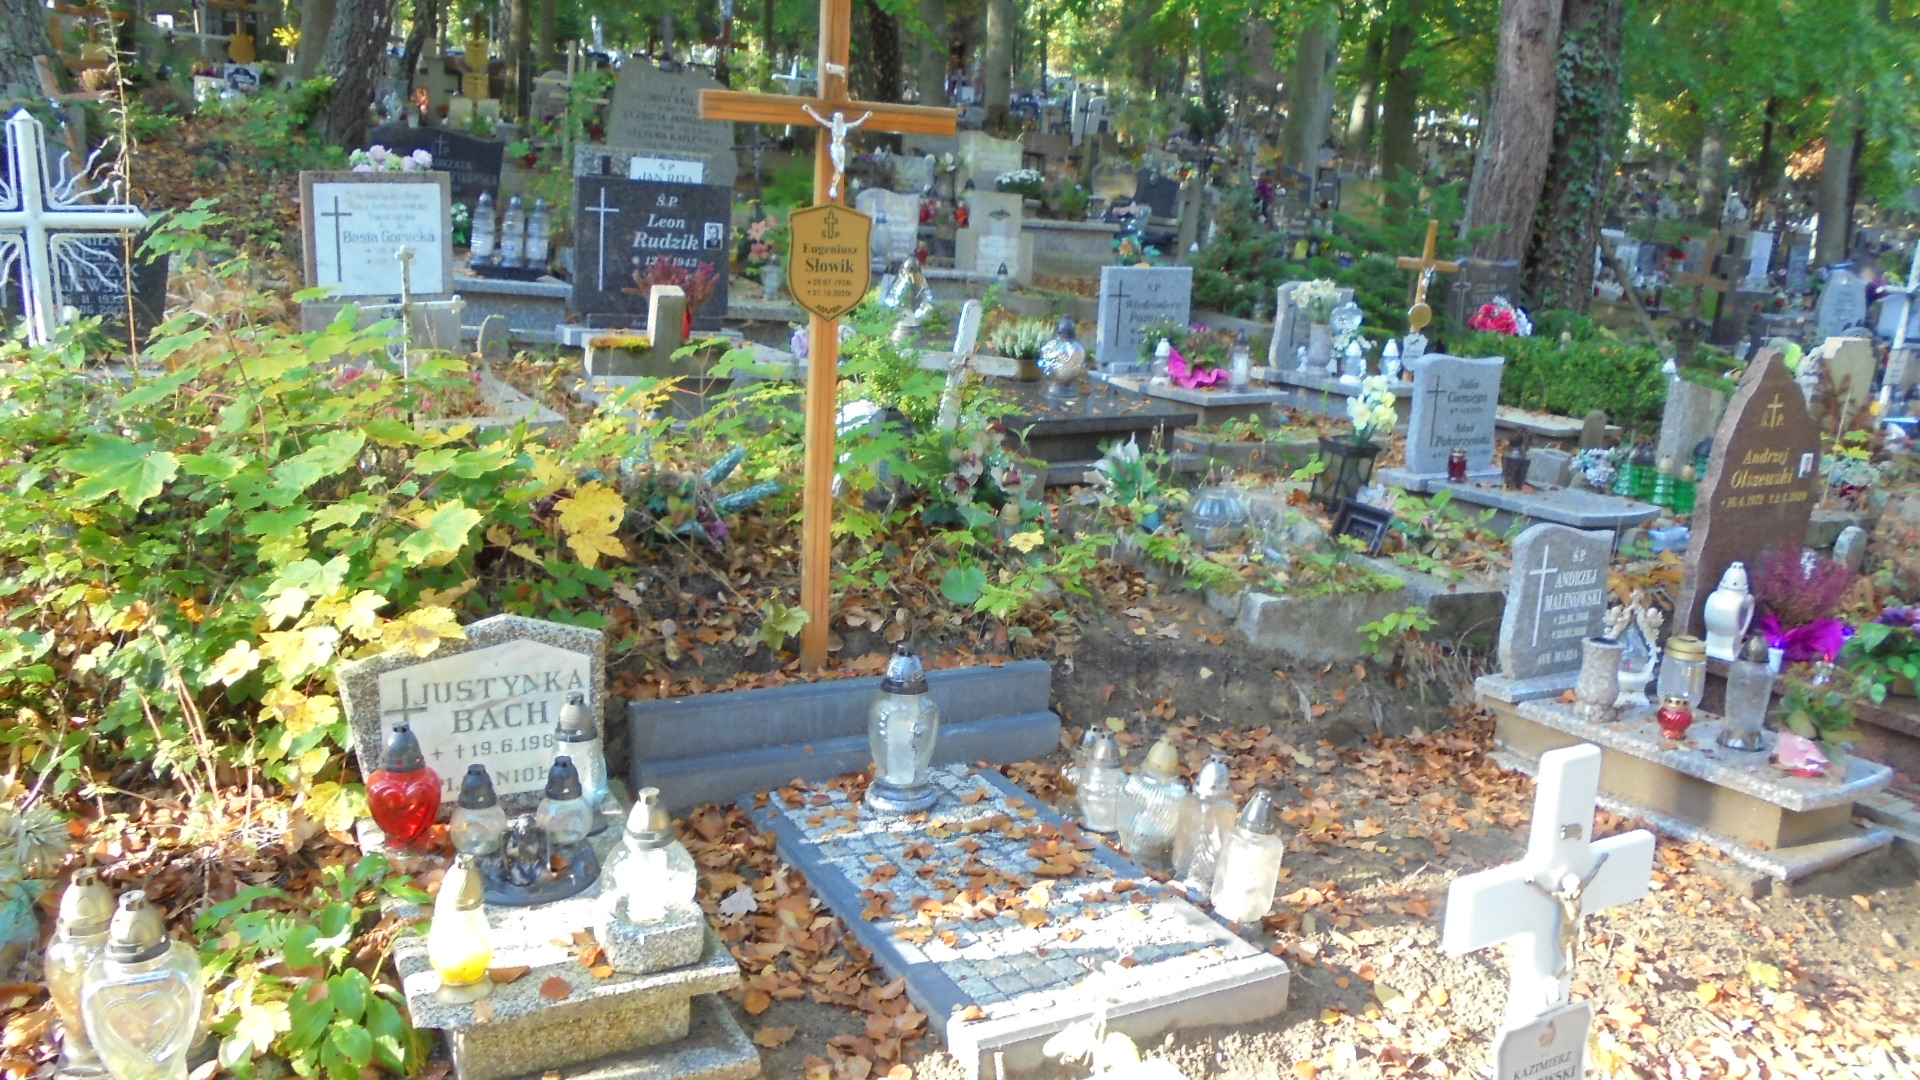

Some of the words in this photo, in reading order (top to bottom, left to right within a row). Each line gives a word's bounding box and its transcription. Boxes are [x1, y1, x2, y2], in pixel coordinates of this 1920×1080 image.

[647, 213, 686, 229] Leon
[343, 230, 378, 244] Basia
[632, 231, 699, 250] Rudzik
[803, 243, 858, 256] Eugeniusz
[805, 257, 854, 274] Słowik
[1742, 446, 1791, 466] Andrzej
[1730, 466, 1795, 489] Olszewski
[1554, 568, 1599, 589] ANDRZEJ
[1543, 587, 1603, 612] MALINOWSKI
[413, 669, 586, 706] JUSTYNKA
[452, 700, 550, 735] BACH
[471, 733, 554, 758] 19.6.198
[1513, 1051, 1572, 1080] KAZIMIERZ
